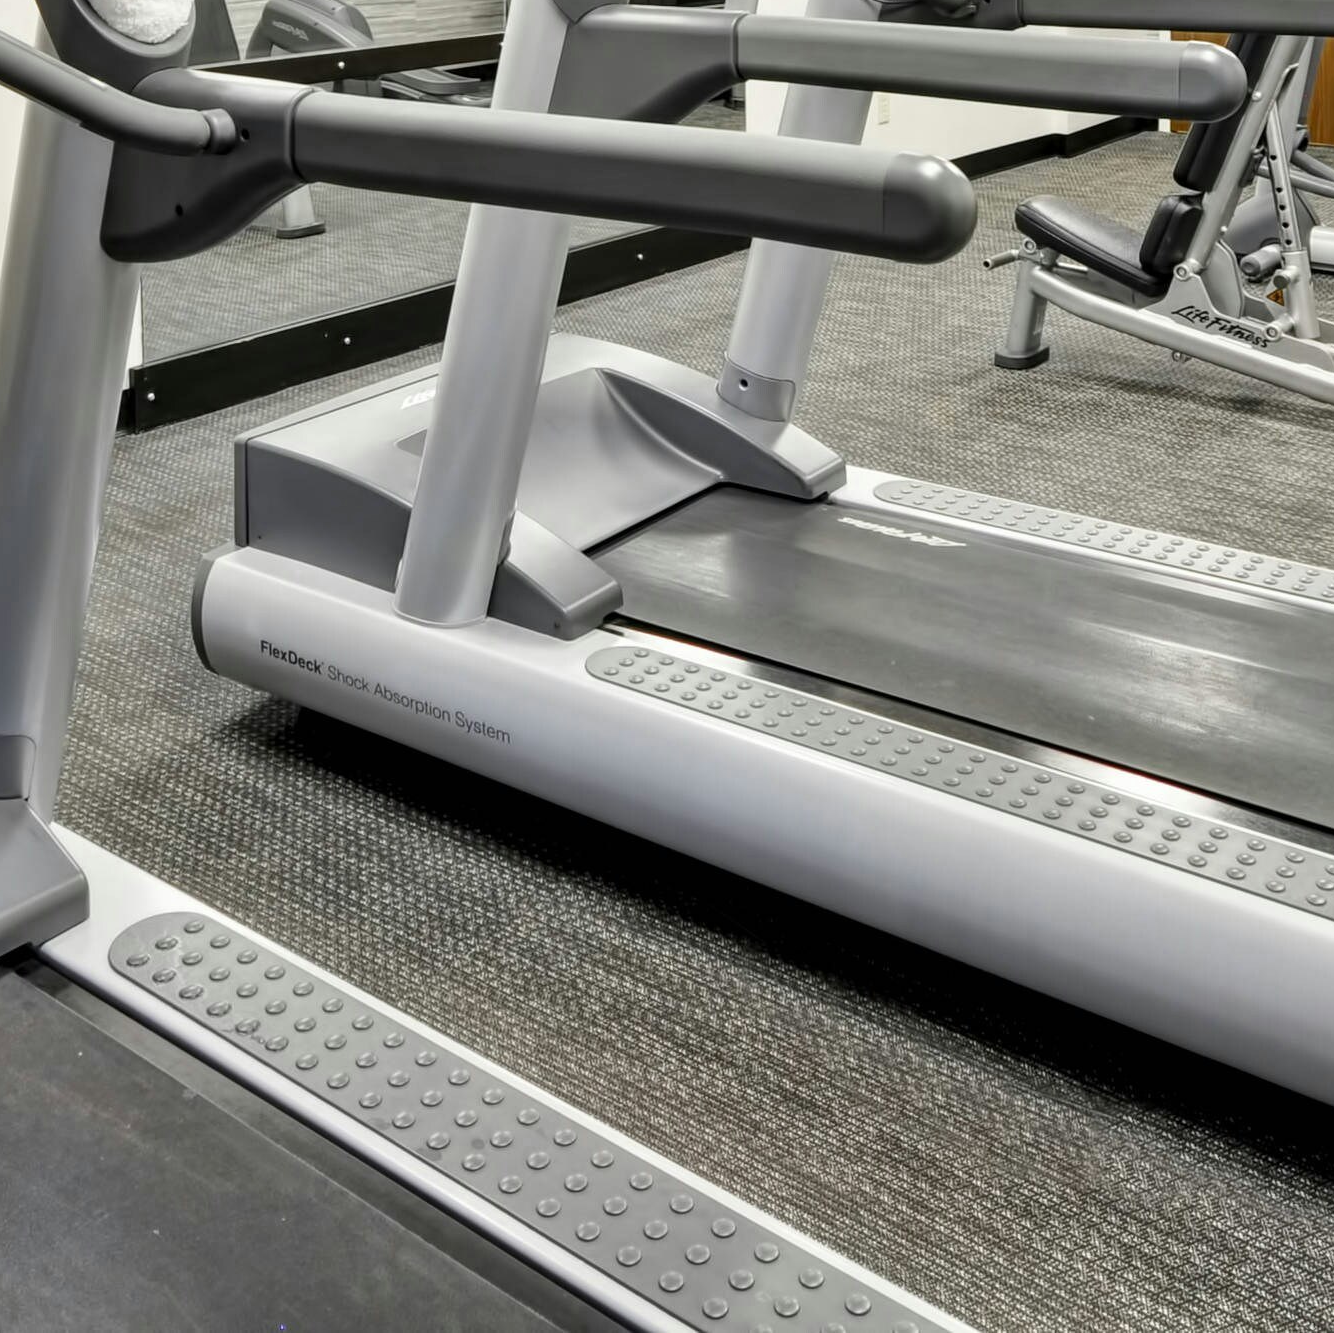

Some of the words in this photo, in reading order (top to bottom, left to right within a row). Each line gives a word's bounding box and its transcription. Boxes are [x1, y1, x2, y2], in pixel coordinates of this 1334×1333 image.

[260, 640, 324, 675] FlexDeck
[327, 664, 369, 693] Shock
[373, 682, 451, 723] Absorption
[454, 710, 512, 745] System
